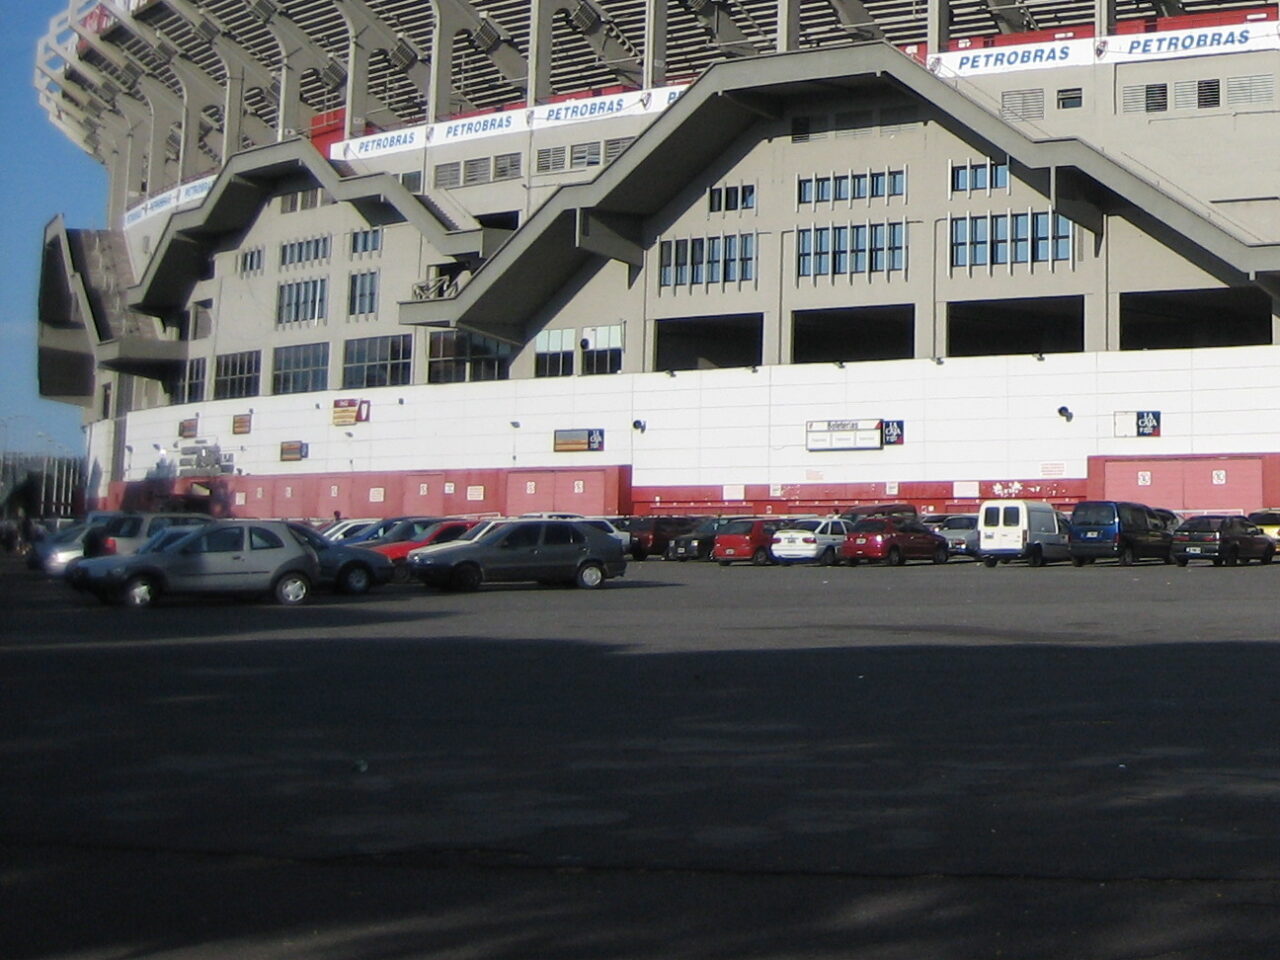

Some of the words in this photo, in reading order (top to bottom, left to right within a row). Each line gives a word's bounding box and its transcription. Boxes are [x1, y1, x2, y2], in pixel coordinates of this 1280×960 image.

[1128, 30, 1250, 54] PETROBRAS
[958, 46, 1070, 70] PETROBRAS
[547, 98, 624, 121] PETROBRAS
[445, 115, 512, 138] PETROBRAS
[358, 132, 415, 153] PETROBRAS
